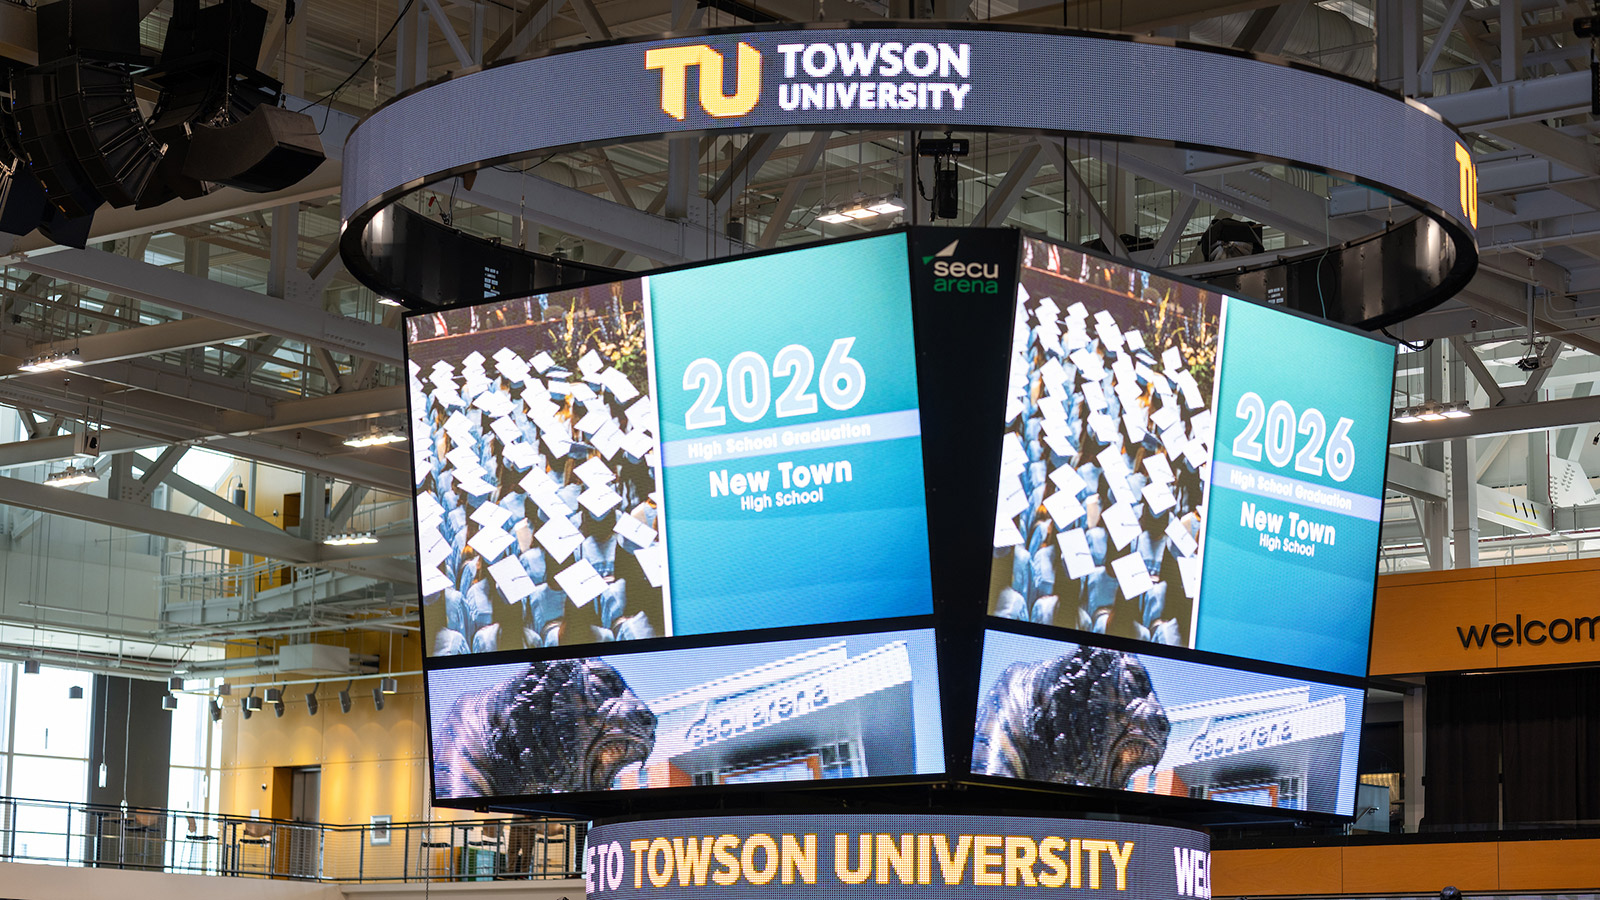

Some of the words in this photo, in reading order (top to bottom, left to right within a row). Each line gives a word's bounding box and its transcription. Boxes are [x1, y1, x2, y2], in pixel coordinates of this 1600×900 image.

[777, 42, 971, 78] TOWSON
[645, 42, 762, 120] TU
[778, 82, 971, 111] UNIVERSITY
[933, 261, 999, 279] secu
[933, 278, 998, 294] arena
[682, 336, 866, 430] 2026
[688, 438, 722, 460] High
[726, 432, 778, 454] School
[781, 422, 871, 446] Graduation
[1232, 391, 1356, 482] 2026
[709, 469, 770, 498] New
[777, 460, 853, 490] Town
[1230, 469, 1255, 490] High
[1257, 475, 1293, 497] School
[1295, 485, 1352, 511] Graduation
[741, 495, 772, 512] High
[775, 487, 824, 507] School
[1240, 501, 1284, 534] New
[1288, 511, 1336, 546] Town
[1259, 533, 1281, 552] High
[1282, 538, 1315, 557] School
[1456, 614, 1600, 650] welcom
[752, 682, 829, 727] arena
[1238, 719, 1293, 750] arena
[597, 840, 624, 892] TO
[630, 833, 818, 889] TOWSON
[834, 833, 1135, 891] UNIVERSITY
